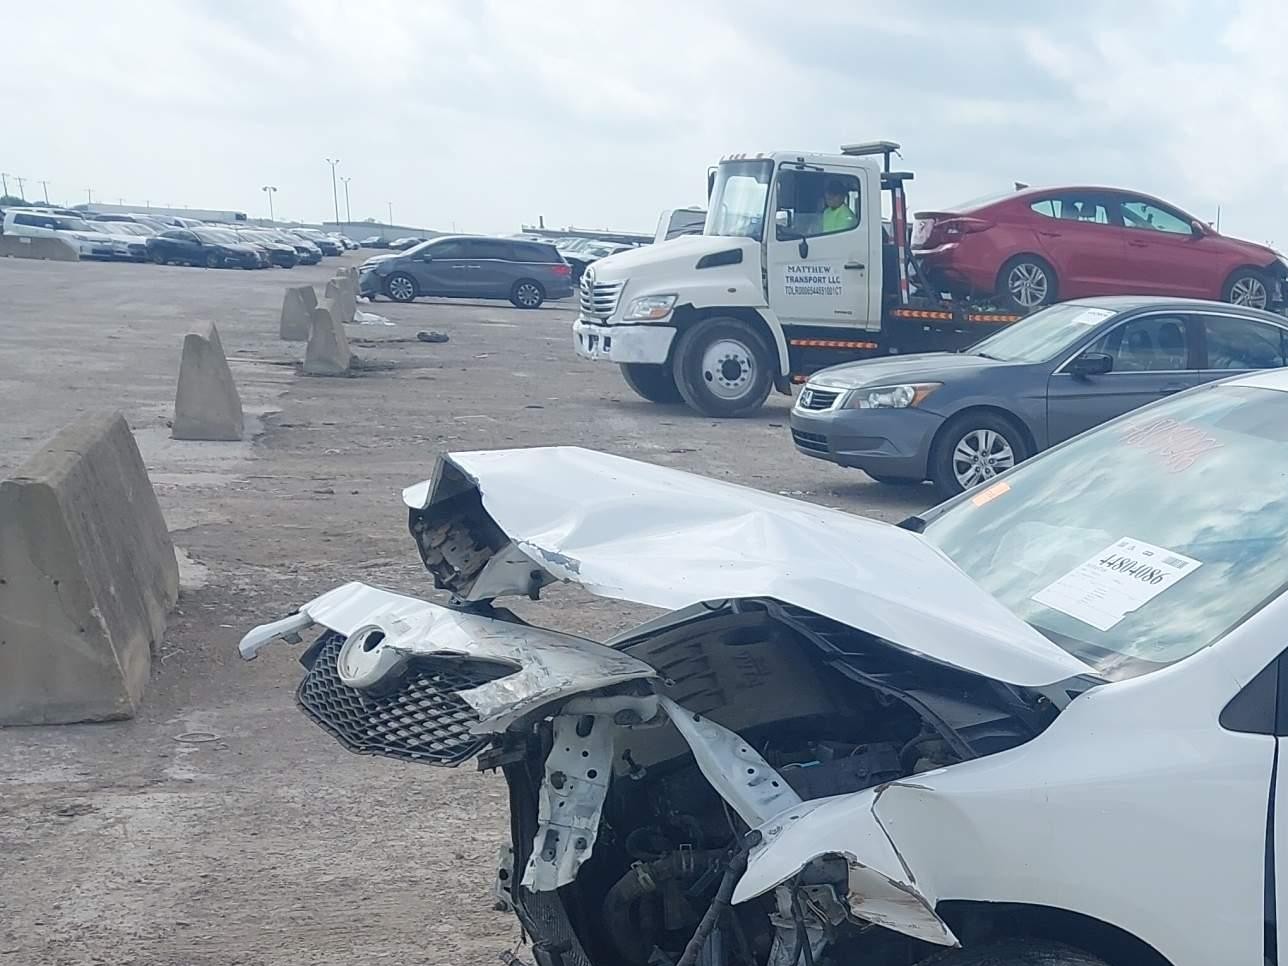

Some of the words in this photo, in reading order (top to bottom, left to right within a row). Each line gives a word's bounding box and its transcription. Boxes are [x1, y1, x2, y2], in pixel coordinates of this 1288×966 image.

[787, 265, 831, 274] MATTHEW
[785, 276, 826, 284] TRANSPORT
[828, 276, 841, 284] LLC
[1099, 553, 1171, 585] 44804086
